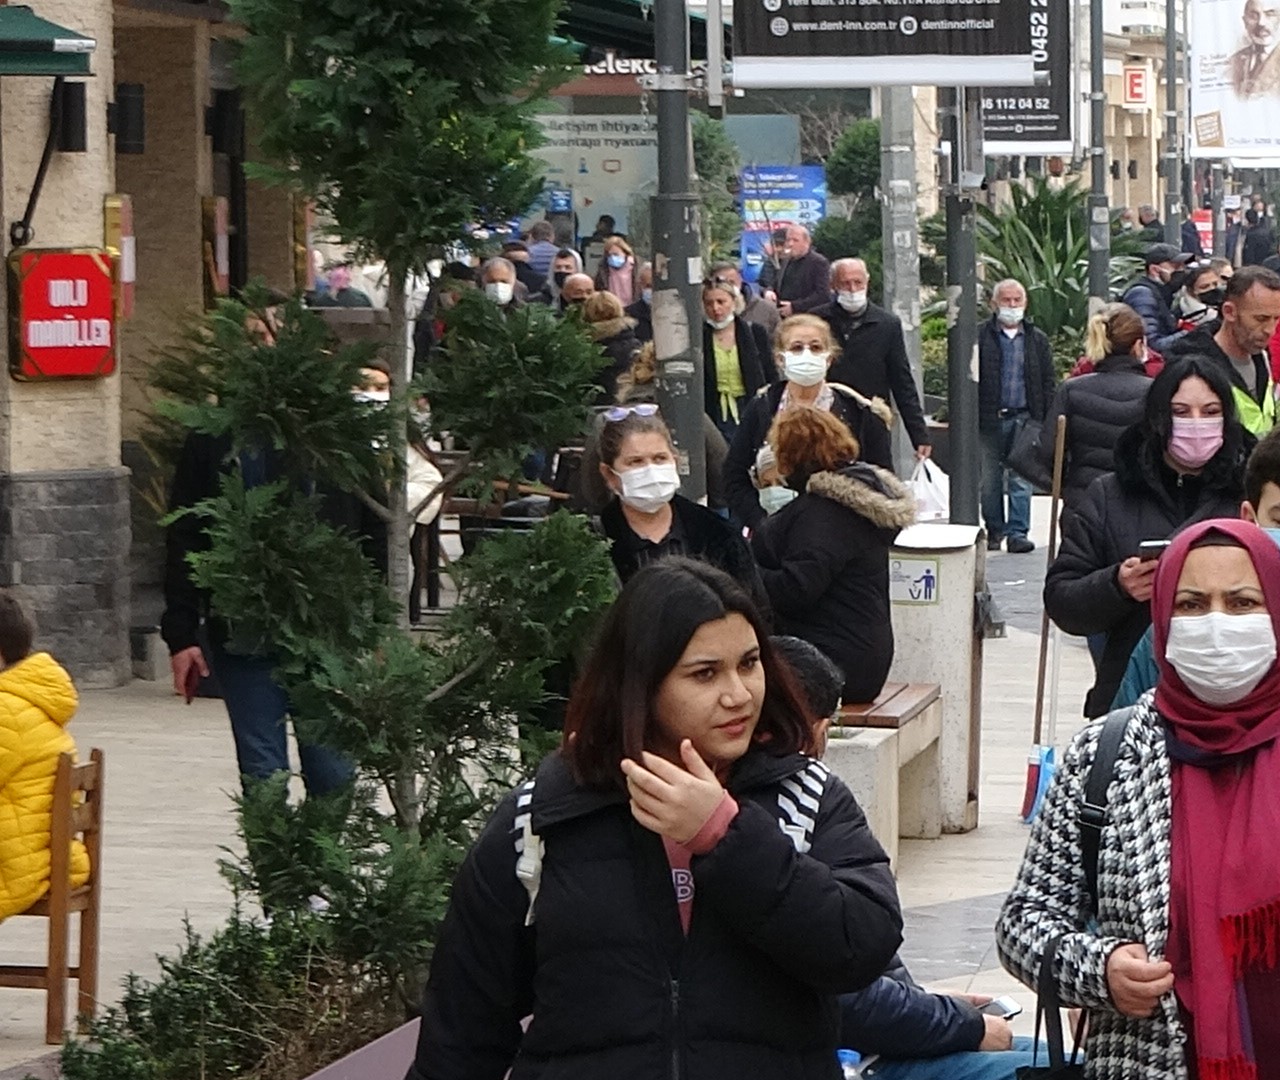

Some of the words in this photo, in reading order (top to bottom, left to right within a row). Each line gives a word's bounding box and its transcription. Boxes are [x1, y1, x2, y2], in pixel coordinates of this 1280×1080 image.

[792, 20, 897, 31] www.dent-inn.com.tr
[921, 18, 994, 30] dentinnofficial
[1129, 73, 1143, 99] E
[995, 98, 1016, 110] 112
[1018, 98, 1033, 110] 04
[1035, 98, 1050, 110] 52
